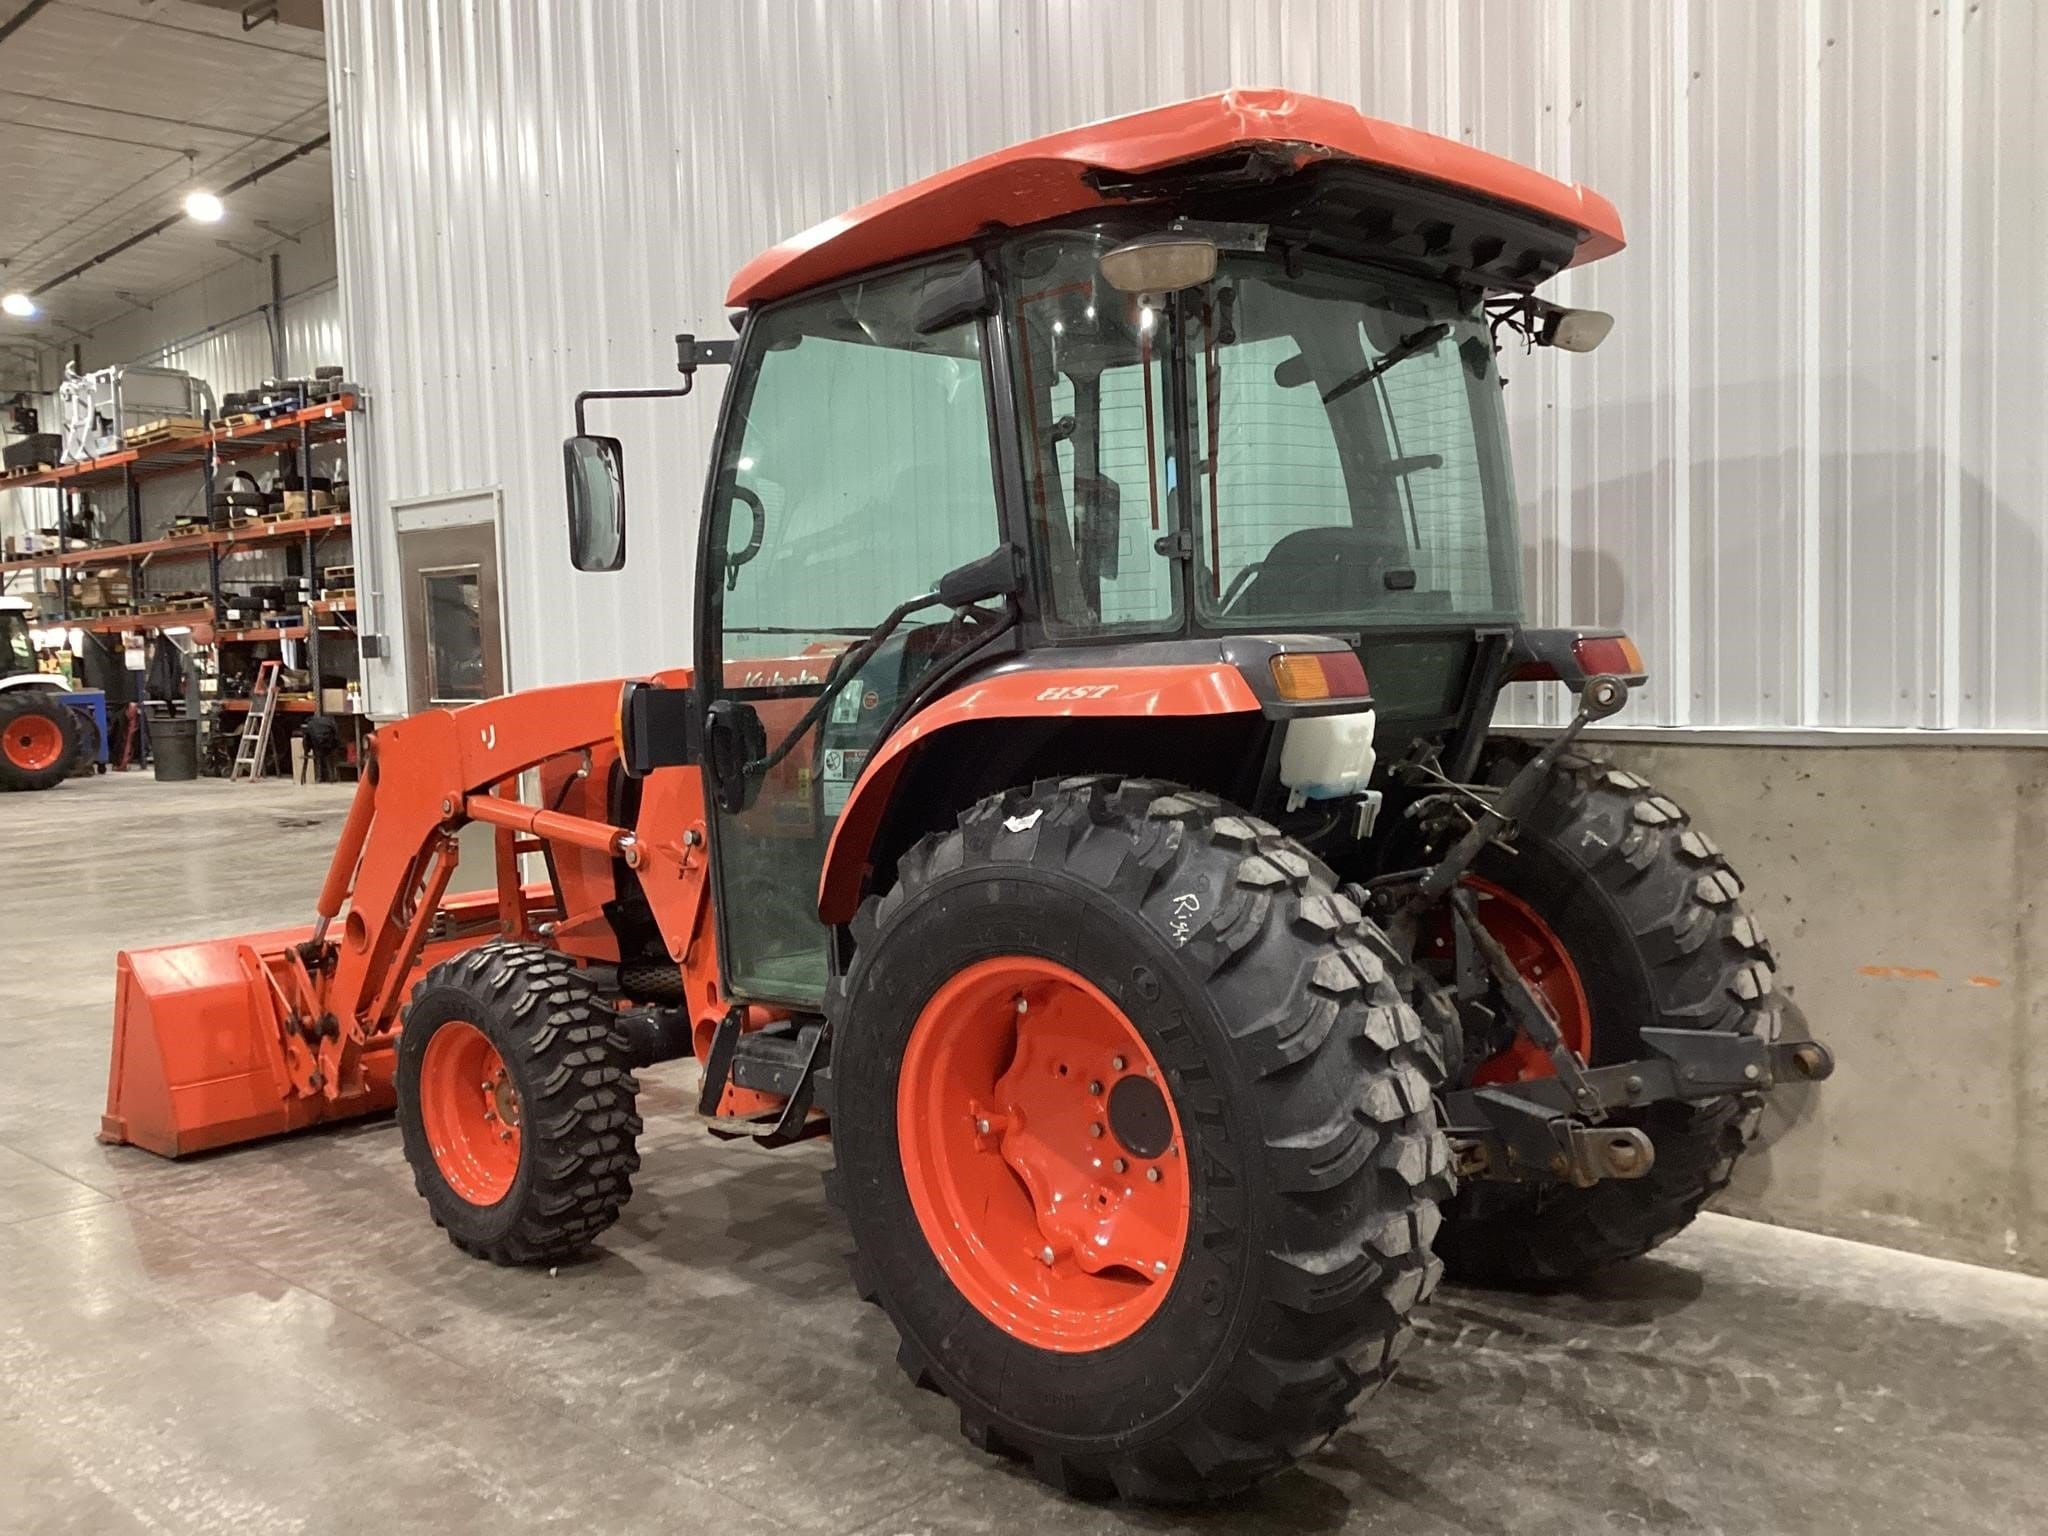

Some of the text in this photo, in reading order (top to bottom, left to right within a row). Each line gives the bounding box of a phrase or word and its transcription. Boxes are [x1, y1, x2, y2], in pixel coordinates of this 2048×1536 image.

[1036, 684, 1119, 701] HST
[1169, 893, 1200, 947] Right
[1156, 1007, 1239, 1278] TITAN
